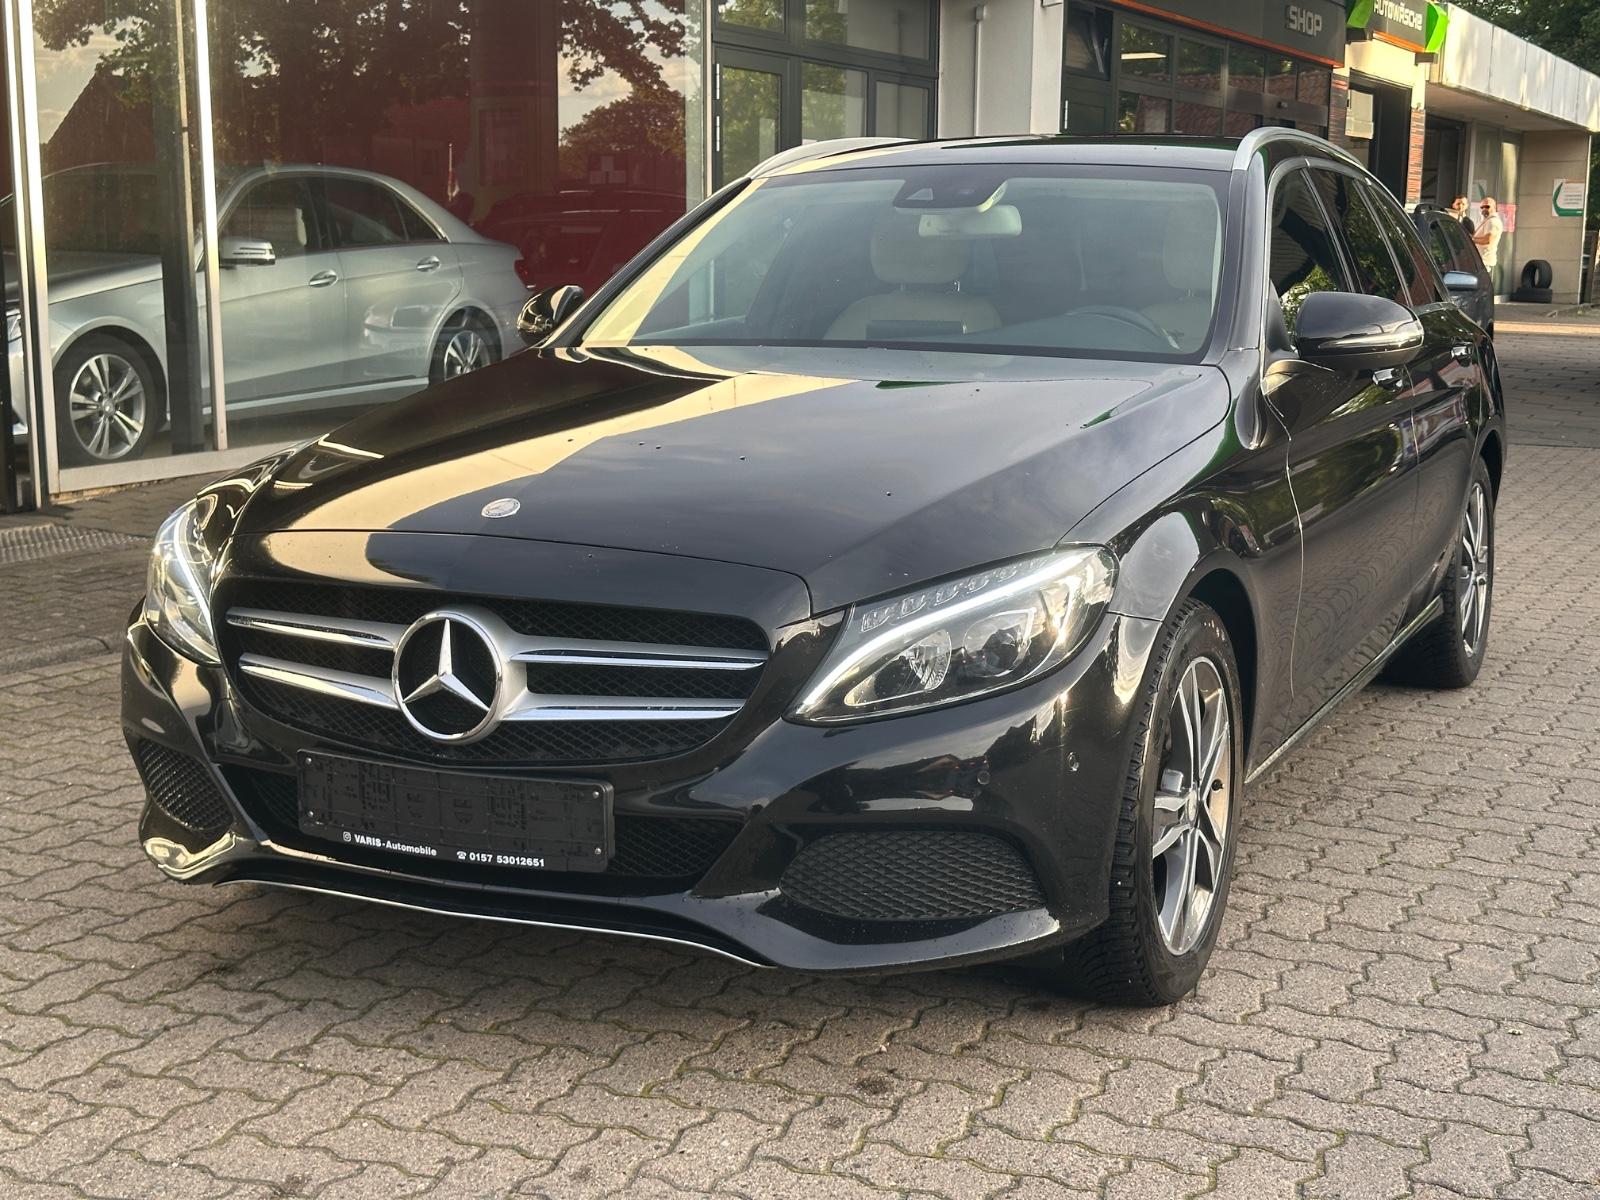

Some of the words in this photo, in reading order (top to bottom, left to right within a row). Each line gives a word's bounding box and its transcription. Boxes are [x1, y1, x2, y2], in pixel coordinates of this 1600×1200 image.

[1287, 5, 1322, 36] SHOP
[354, 834, 437, 857] VARIS-Automobile
[469, 851, 493, 863] 0157
[497, 854, 545, 867] 53012651
